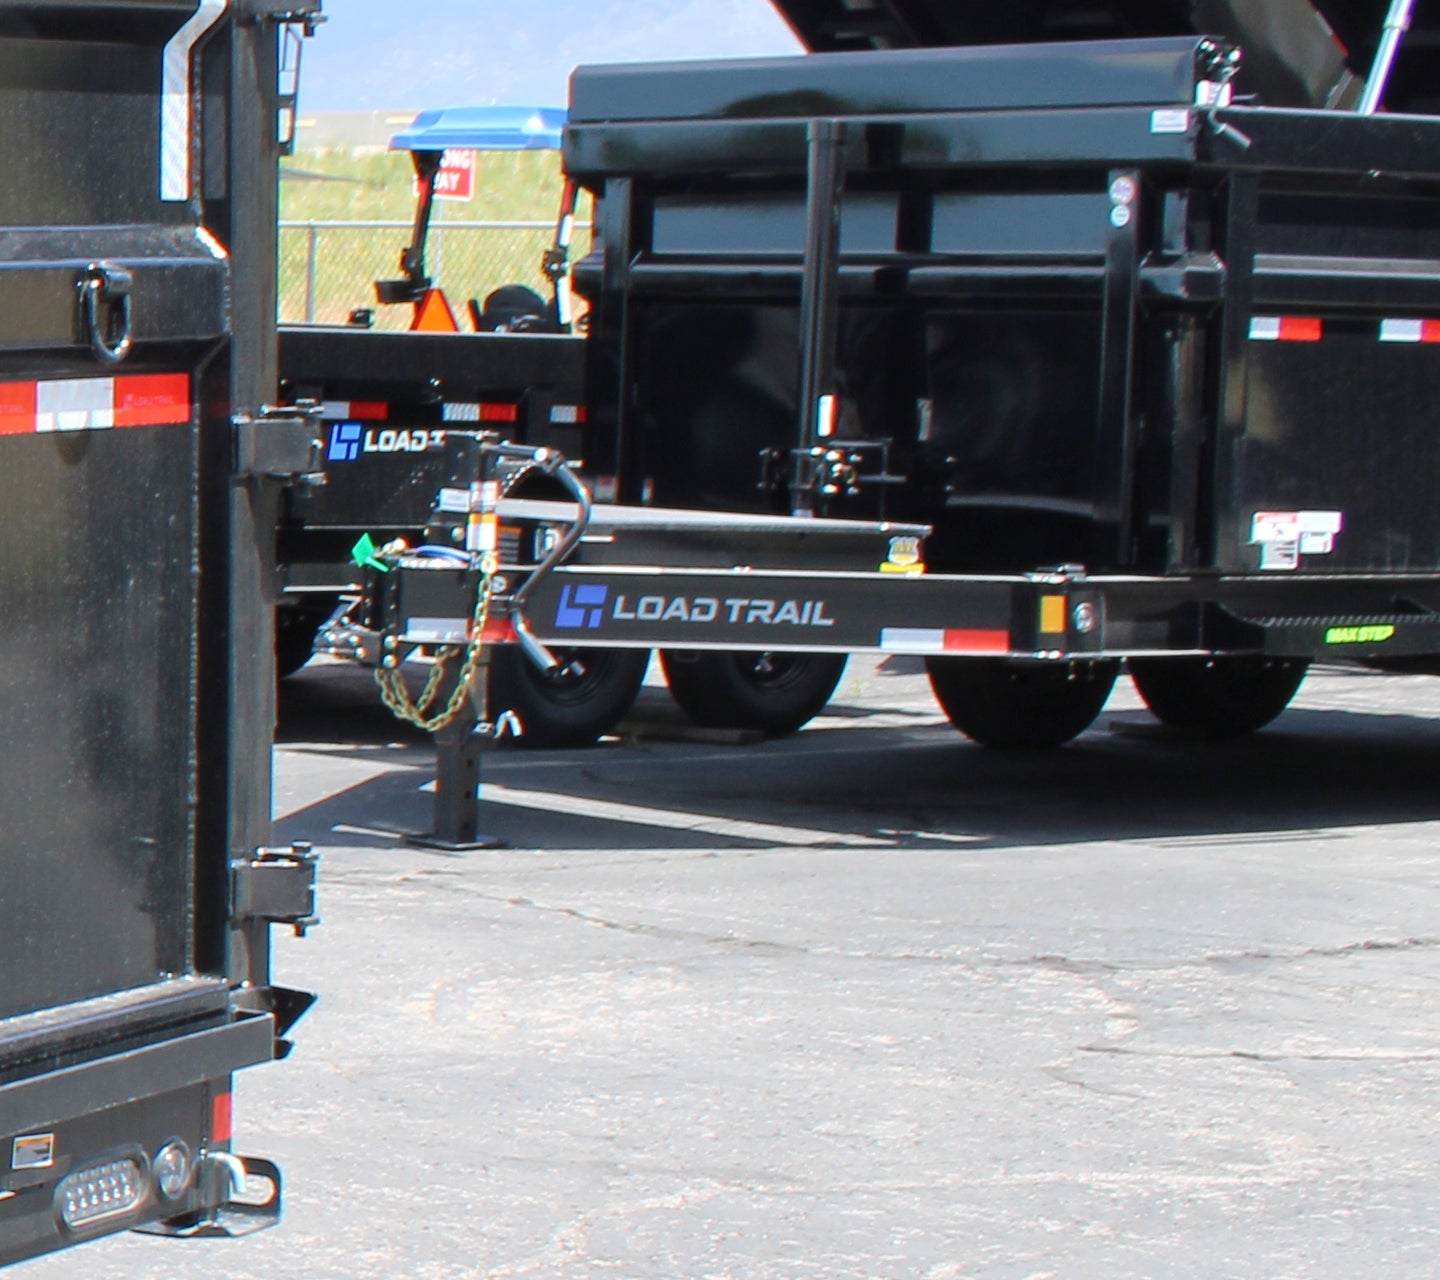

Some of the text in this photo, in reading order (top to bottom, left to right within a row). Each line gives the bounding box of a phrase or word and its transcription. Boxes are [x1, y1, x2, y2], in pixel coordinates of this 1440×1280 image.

[364, 430, 428, 451] LOAD
[613, 595, 834, 626] LOAD TRAIL
